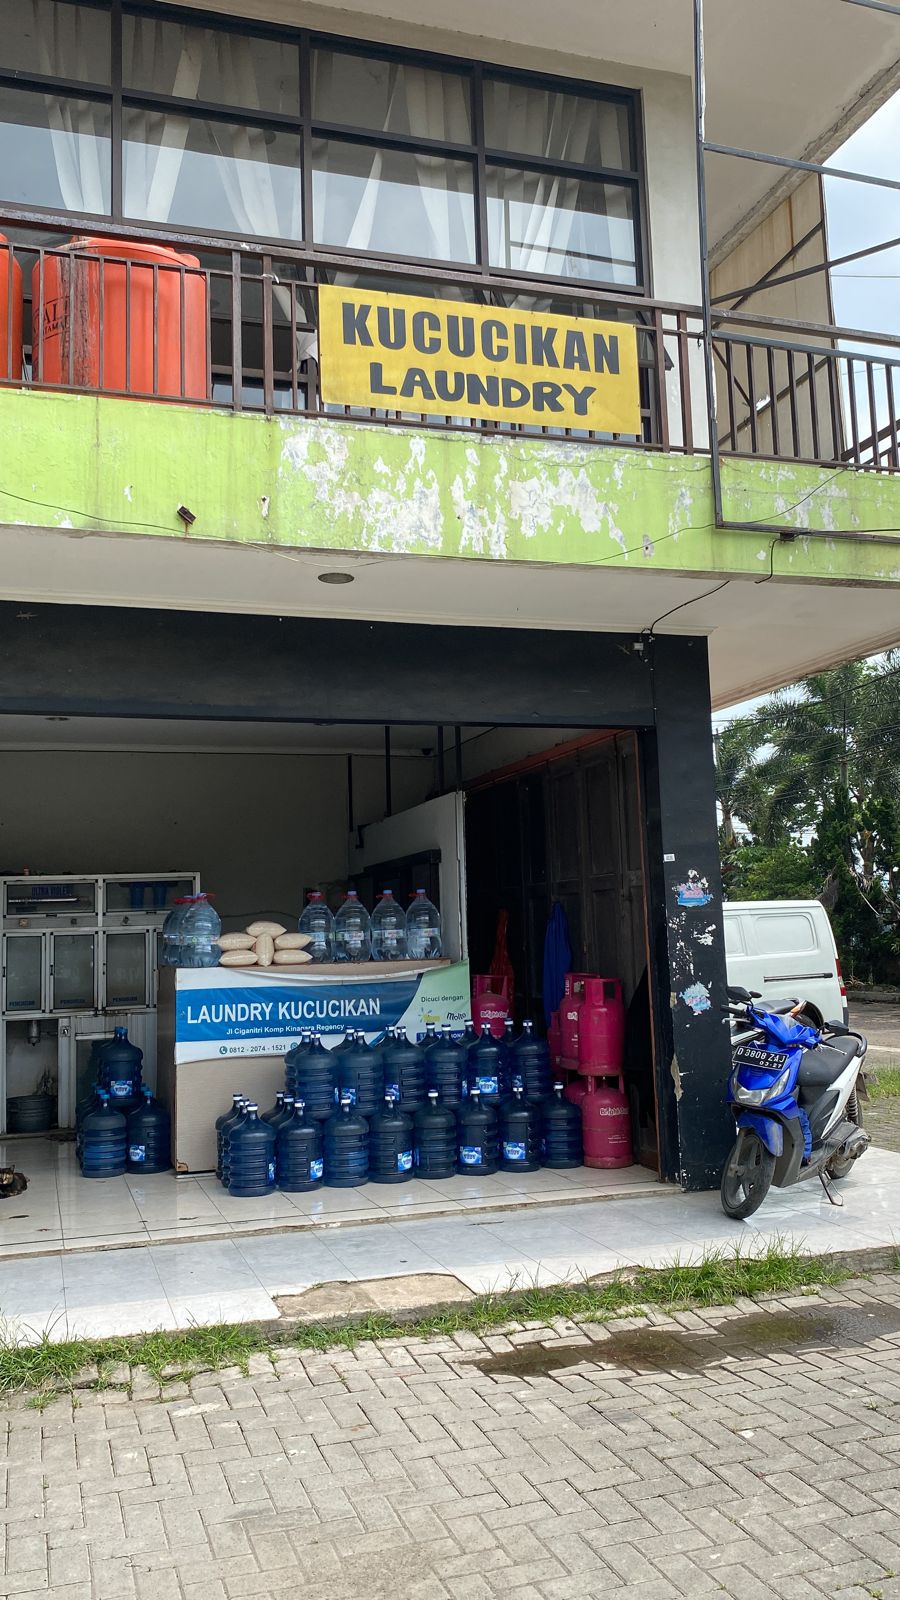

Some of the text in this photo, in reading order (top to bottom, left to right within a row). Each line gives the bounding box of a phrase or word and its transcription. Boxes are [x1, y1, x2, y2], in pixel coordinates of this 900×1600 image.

[341, 302, 620, 375] KUCUCIKAN
[369, 361, 597, 416] LAUNDRY
[187, 997, 381, 1024] LAUNDRY KUCUCIKAN
[446, 1012, 466, 1020] Molto
[234, 1026, 263, 1036] Ciganitri
[264, 1026, 284, 1035] Komp
[316, 1023, 345, 1032] Regency
[229, 1046, 245, 1054] 0812
[250, 1045, 266, 1053] 2074
[737, 1047, 786, 1063] D 3808 ZAJ
